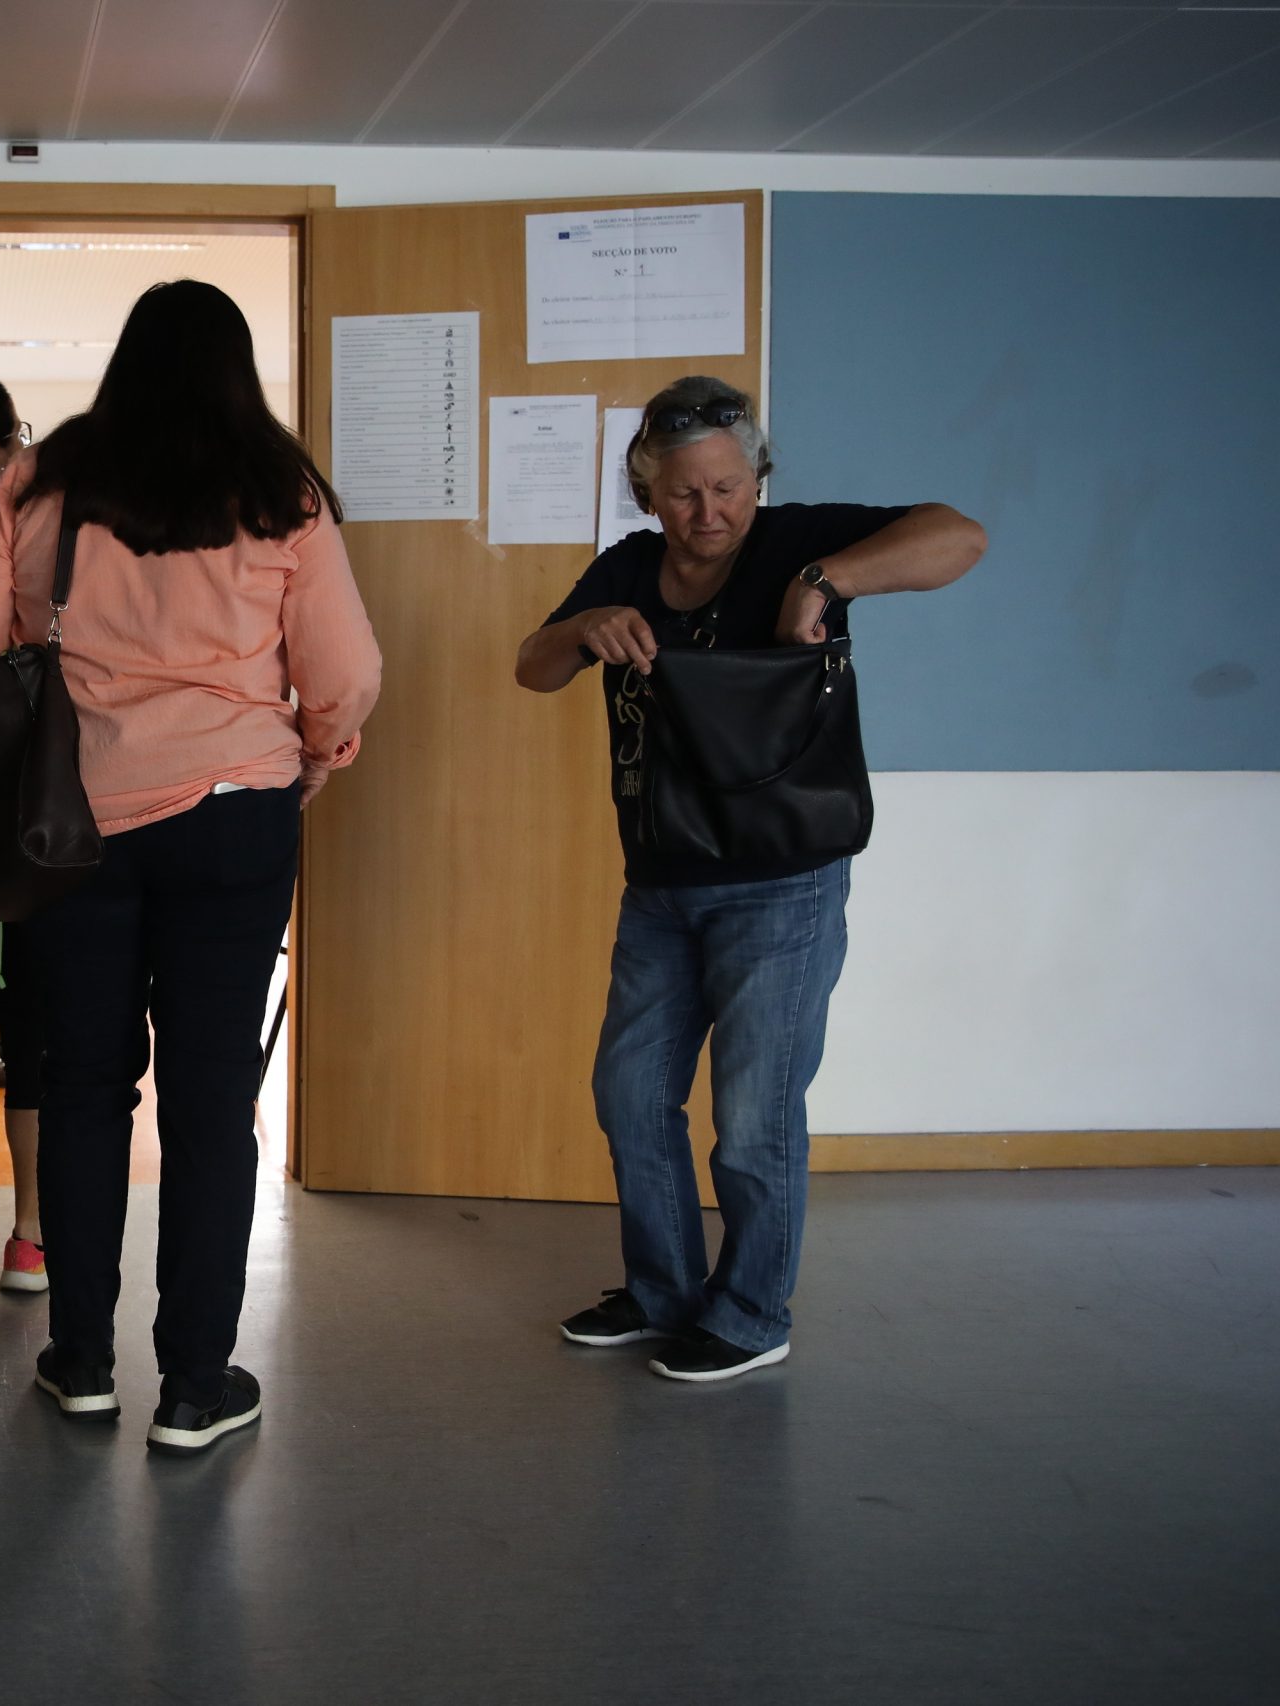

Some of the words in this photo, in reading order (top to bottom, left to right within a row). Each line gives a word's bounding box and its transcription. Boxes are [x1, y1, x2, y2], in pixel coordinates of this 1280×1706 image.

[592, 247, 632, 259] SECÇÃO
[634, 247, 648, 256] DE
[649, 246, 678, 255] VOTO
